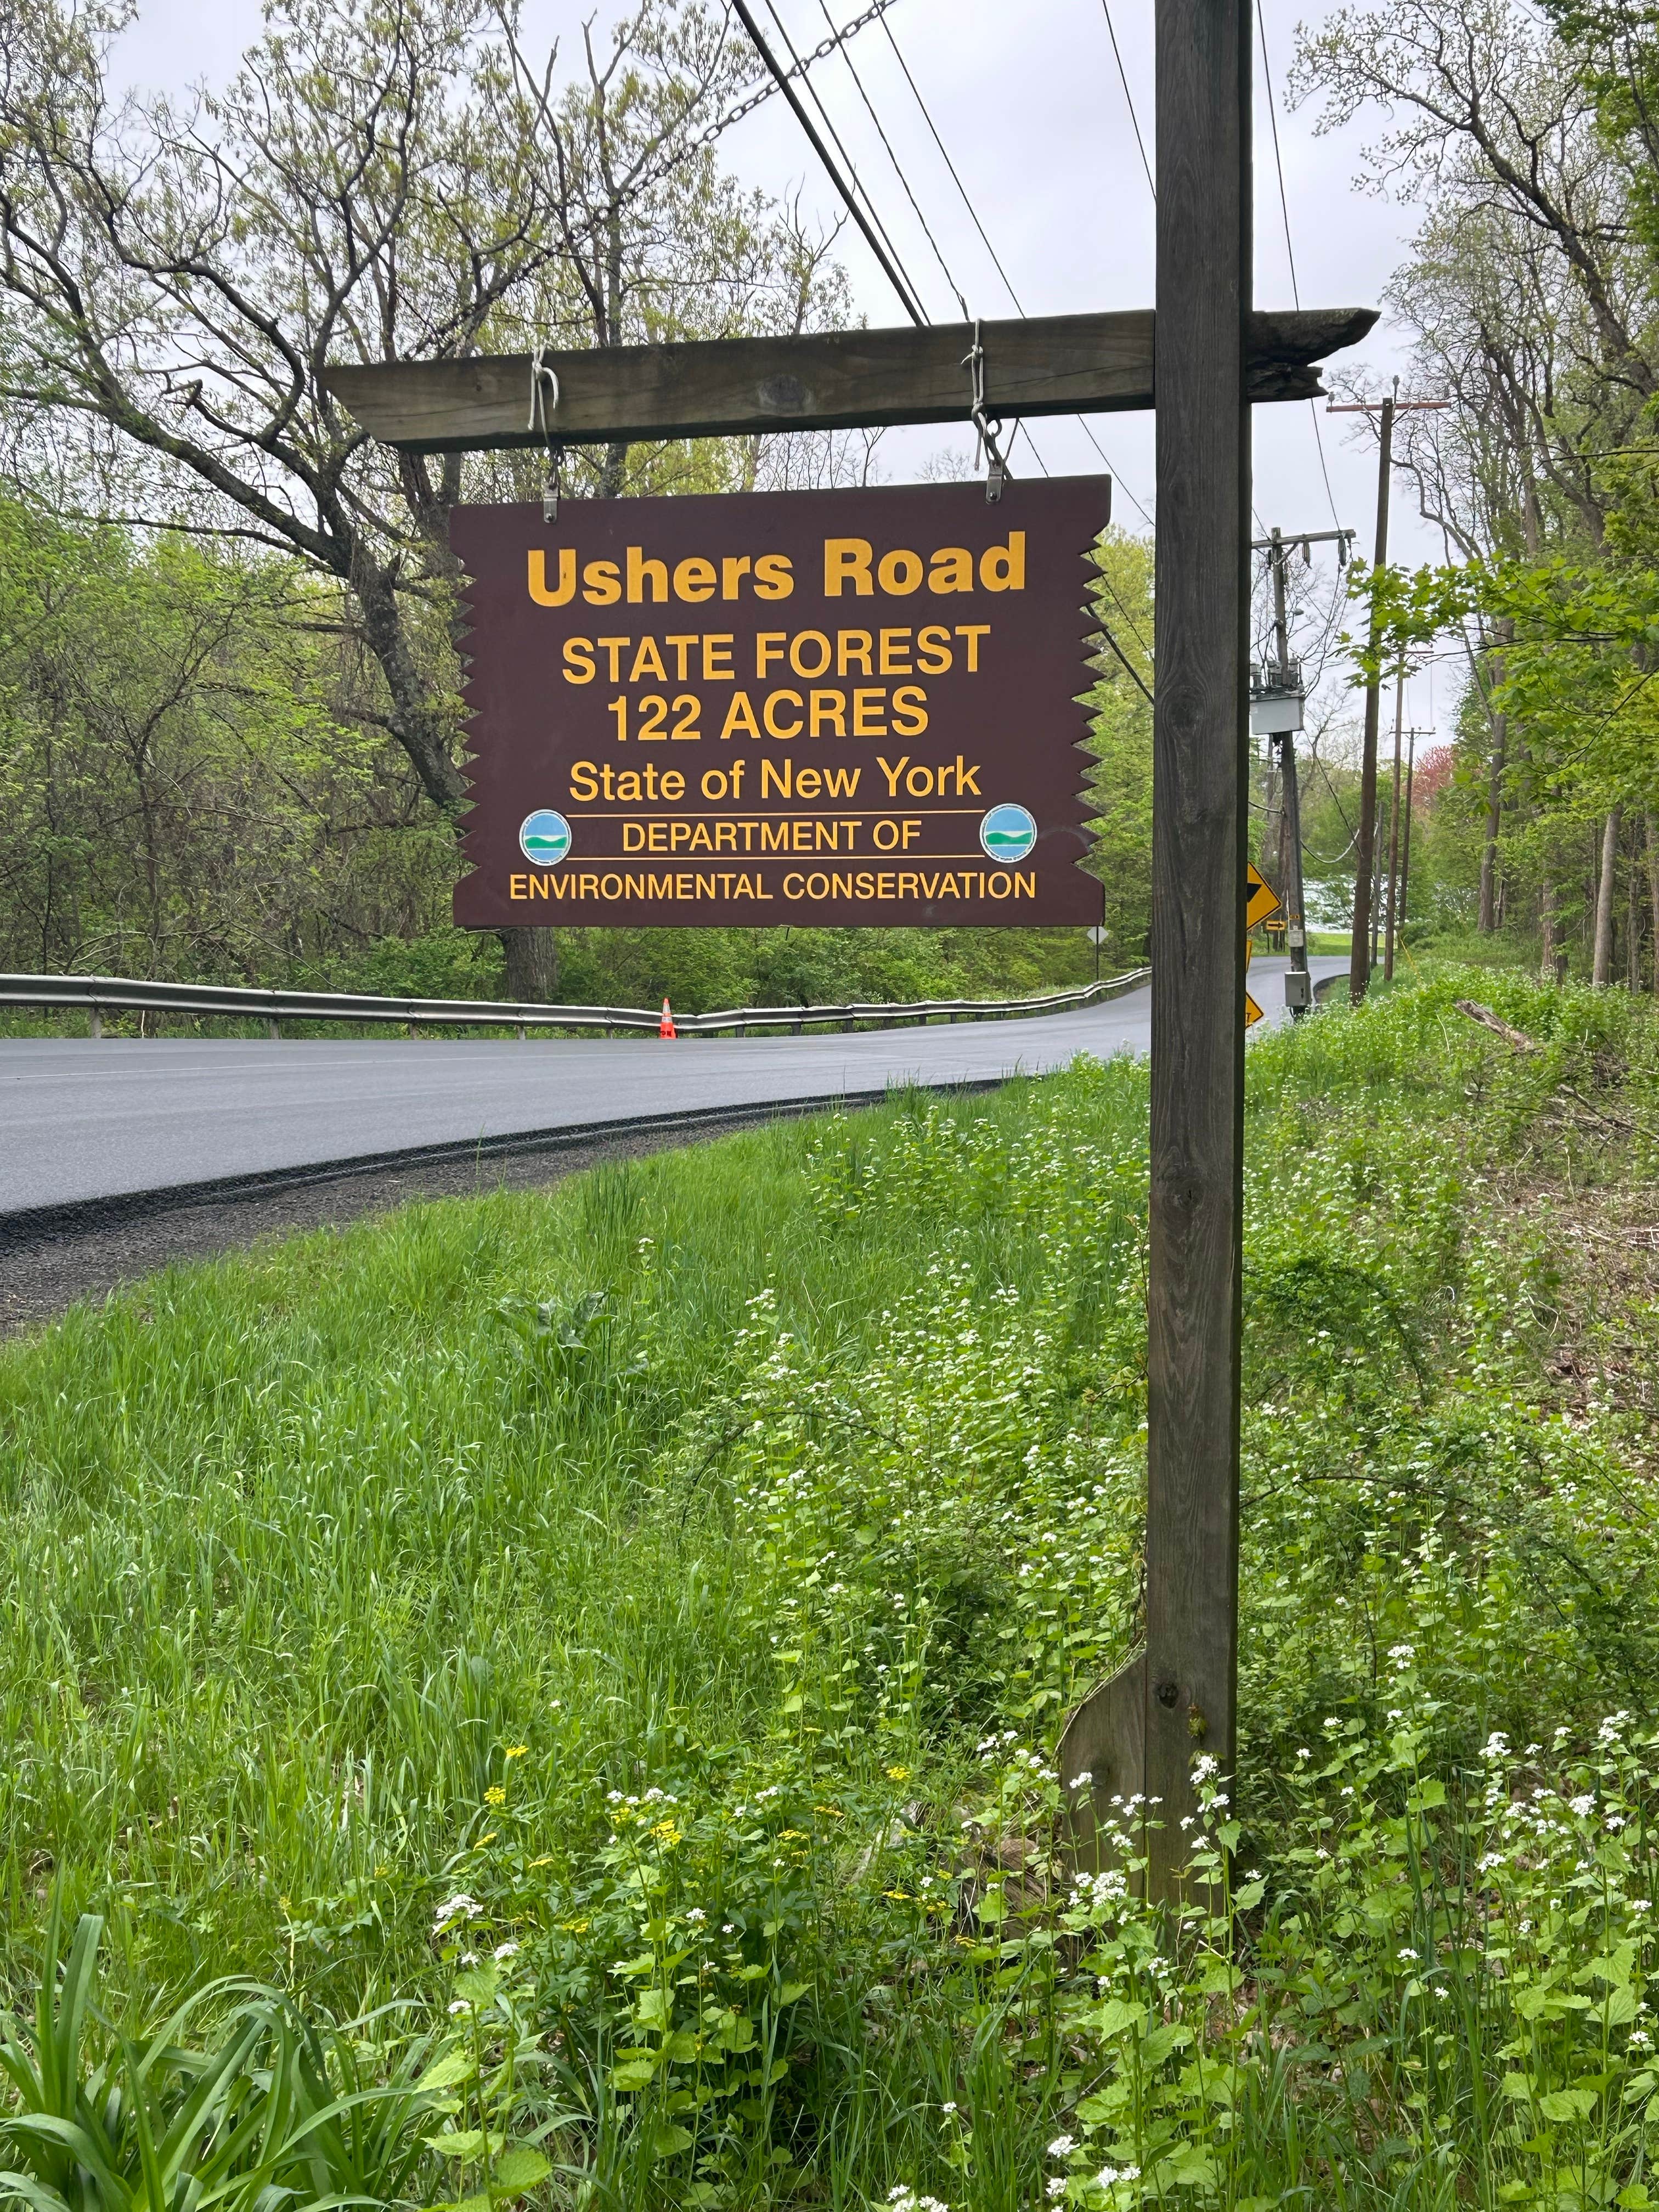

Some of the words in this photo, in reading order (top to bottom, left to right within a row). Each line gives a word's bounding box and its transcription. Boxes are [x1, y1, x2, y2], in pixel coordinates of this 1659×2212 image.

[527, 546, 794, 607] Ushers
[824, 531, 1025, 597] Road
[562, 634, 735, 685] STATE
[756, 624, 991, 679] FOREST
[607, 694, 701, 741] 122
[720, 685, 928, 740] ACRES
[569, 761, 686, 802] State
[701, 759, 745, 800] of
[761, 758, 861, 799] New
[877, 755, 981, 797] York
[623, 821, 862, 851] DEPARTMENT
[873, 820, 921, 850] OF
[510, 873, 773, 900] ENVIRONMENTAL
[783, 871, 1036, 900] CONSERVATION
